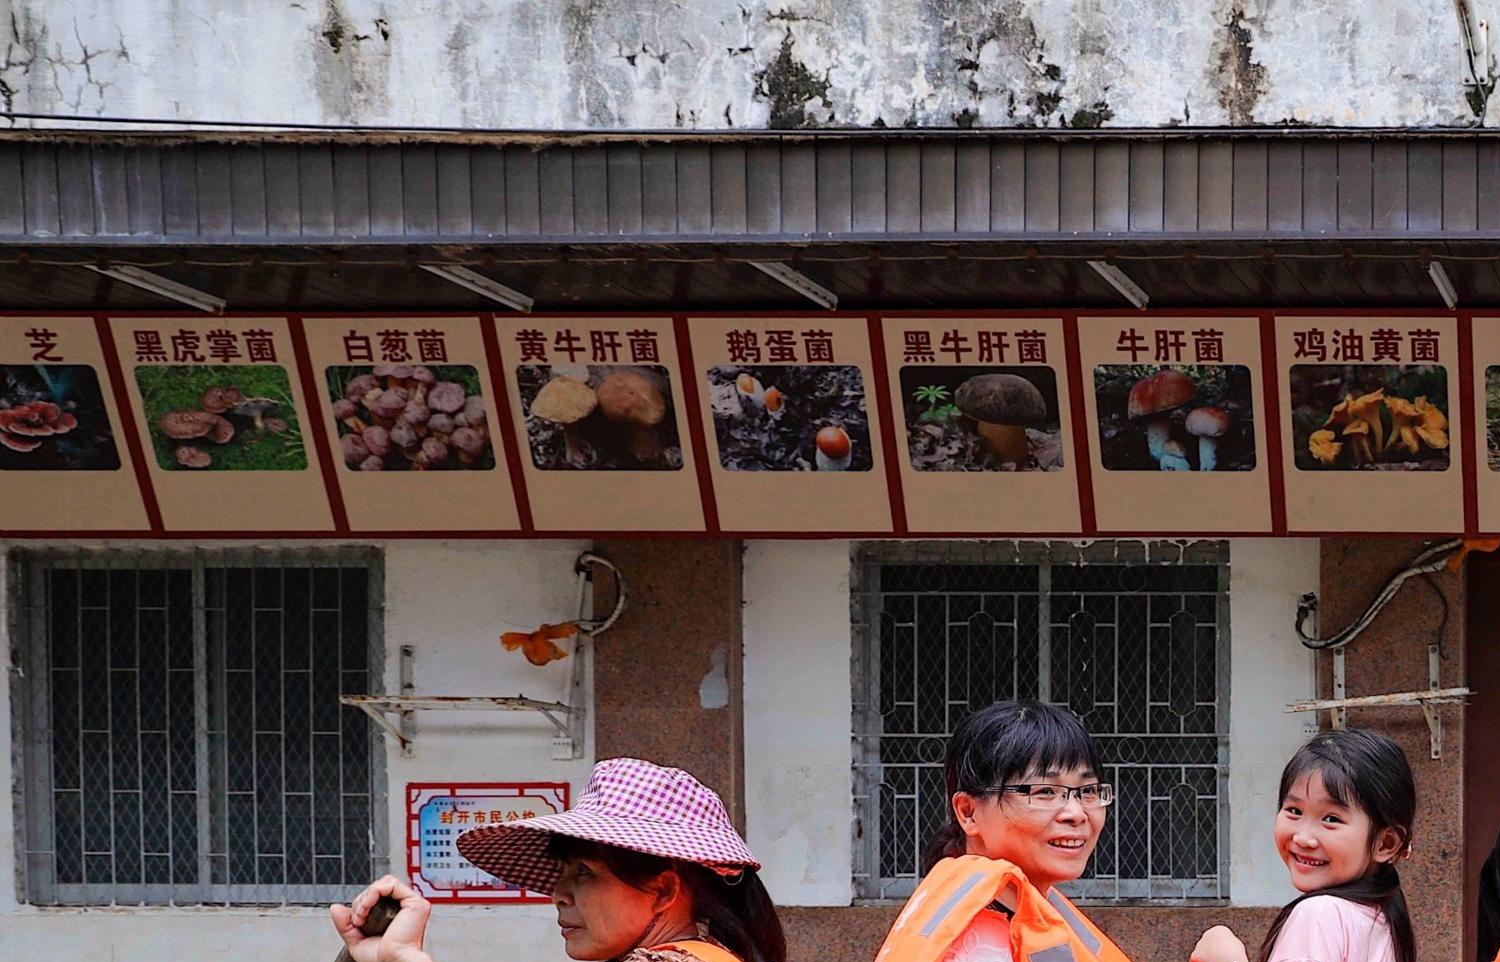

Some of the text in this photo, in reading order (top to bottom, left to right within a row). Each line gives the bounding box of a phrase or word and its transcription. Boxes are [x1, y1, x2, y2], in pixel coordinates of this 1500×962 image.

[24, 328, 63, 362] 芝
[133, 329, 277, 362] 黑虎掌菌
[343, 329, 448, 362] 白葱菌
[516, 329, 659, 362] 黄牛肝菌
[726, 329, 834, 363] 鹅蛋菌
[904, 329, 1047, 363] 黑牛肝菌
[1116, 328, 1223, 362] 牛肝菌
[1294, 328, 1440, 362] 鸡油黄菌
